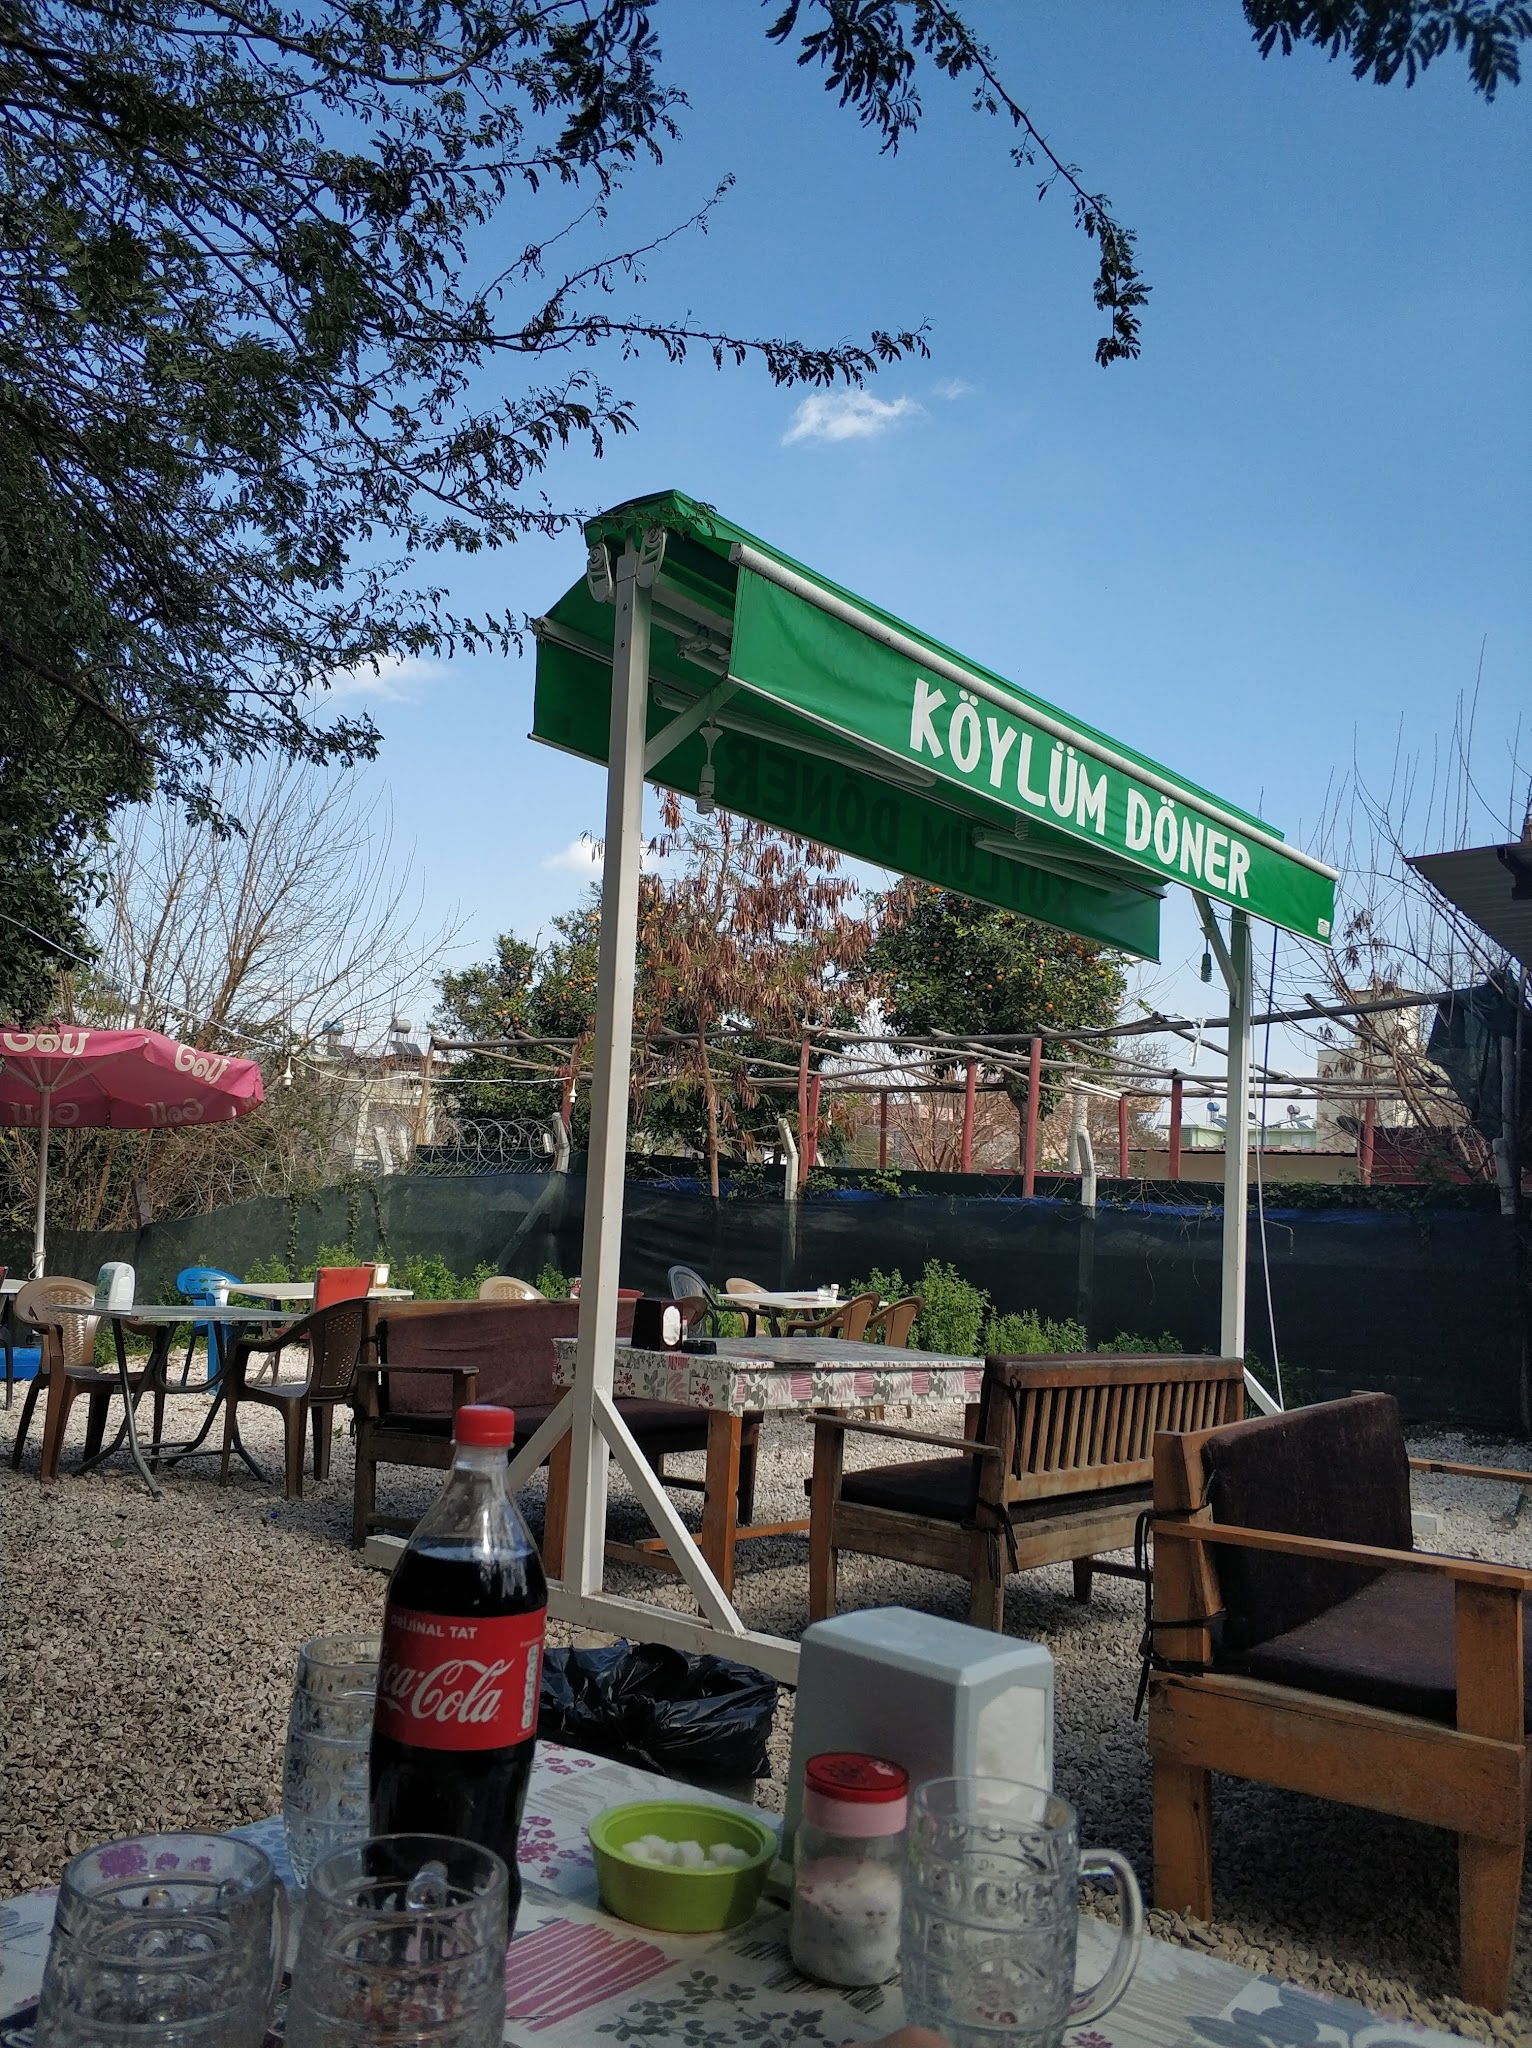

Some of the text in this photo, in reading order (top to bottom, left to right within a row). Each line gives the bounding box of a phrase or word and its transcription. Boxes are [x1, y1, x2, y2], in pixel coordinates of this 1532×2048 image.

[909, 677, 1251, 899] KÖYLÜM DÖNER
[174, 1043, 231, 1085] Golf
[449, 1625, 478, 1640] TAT
